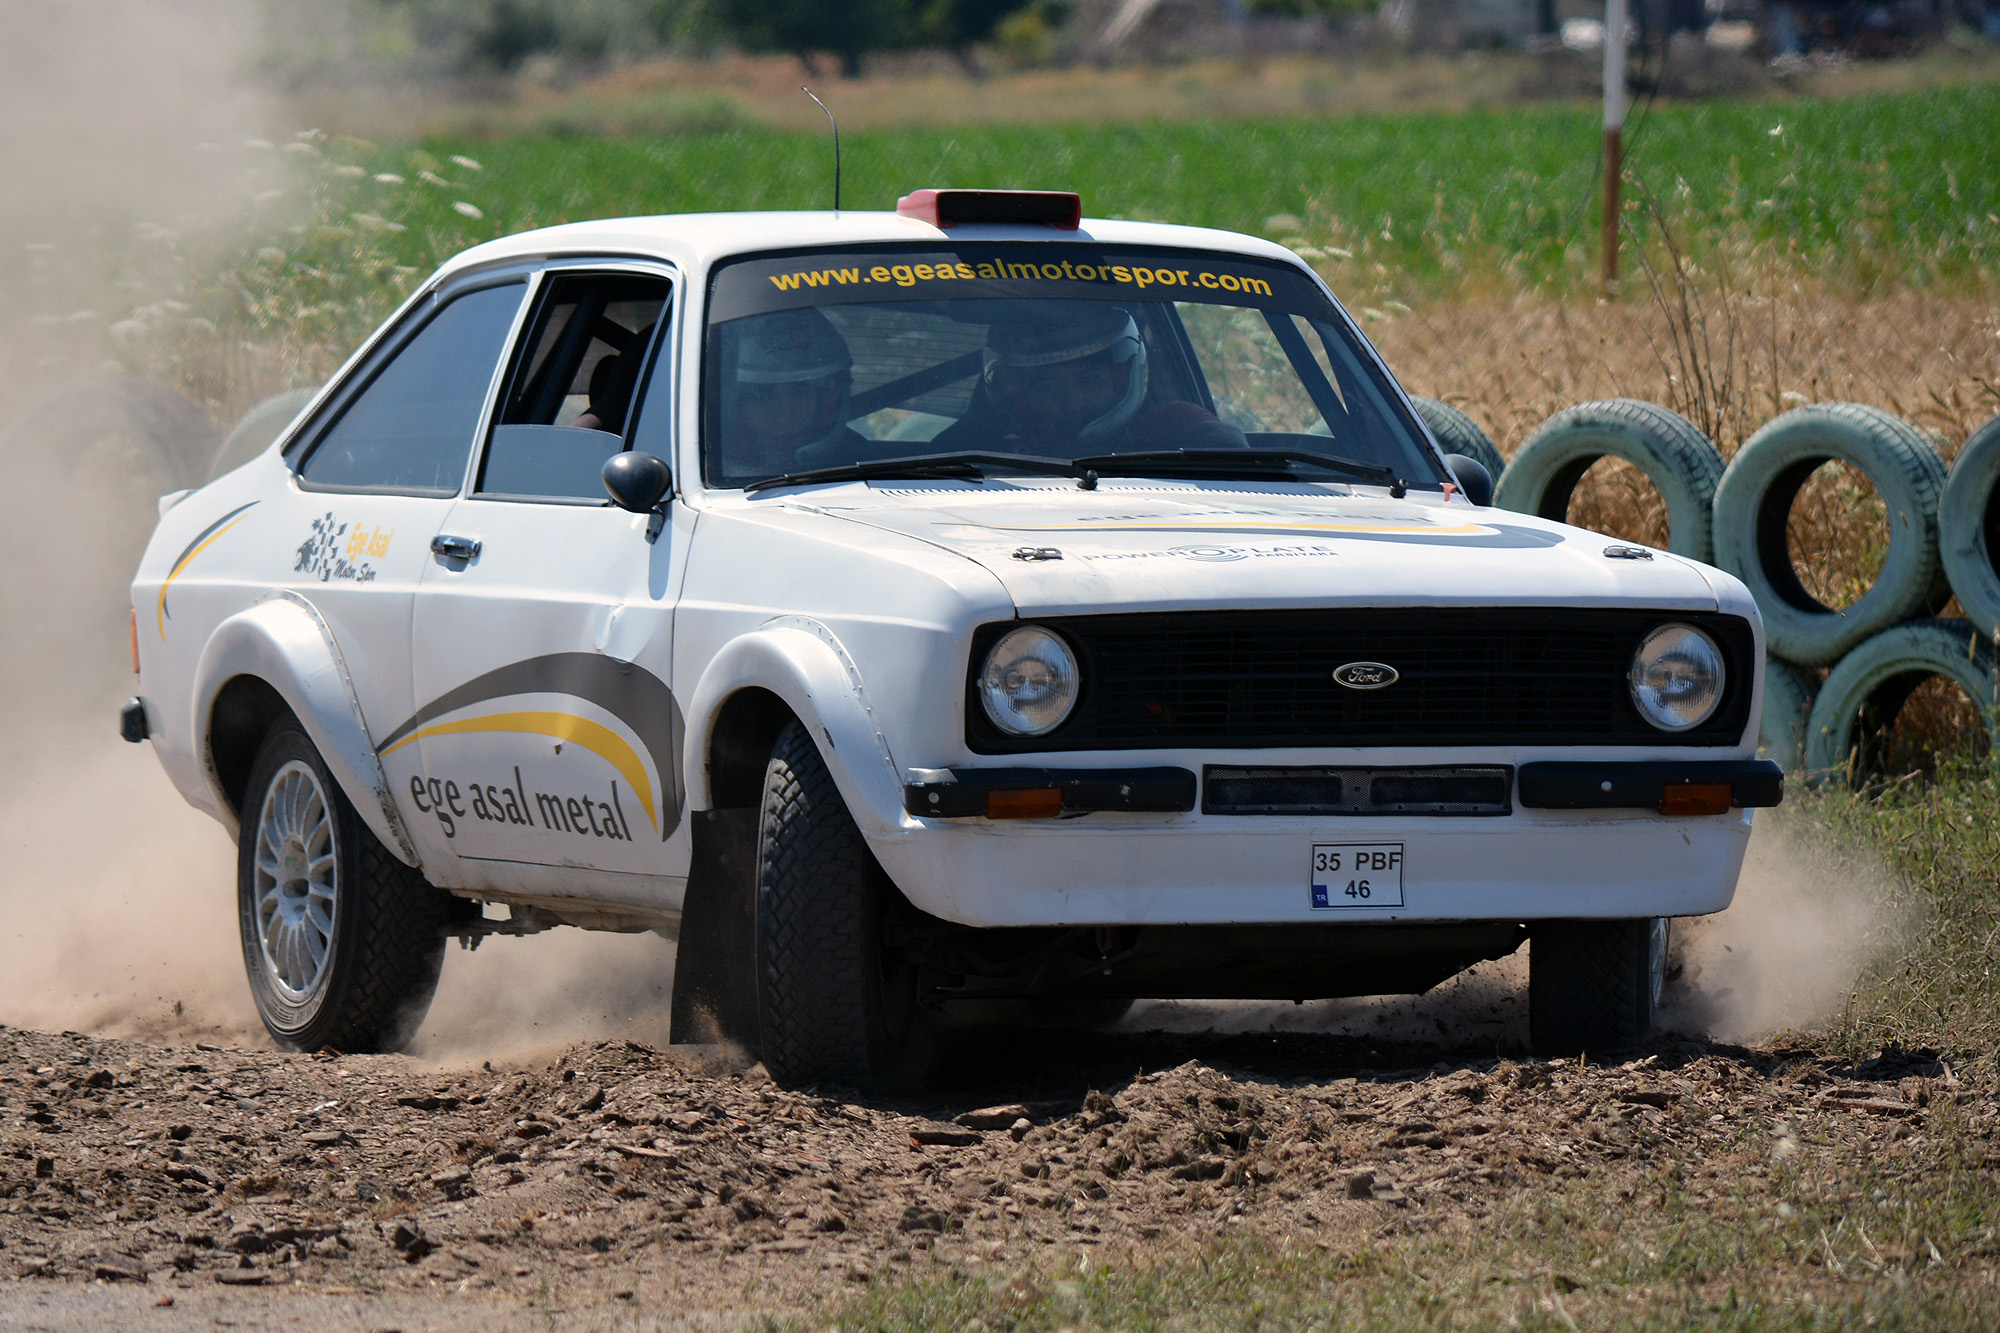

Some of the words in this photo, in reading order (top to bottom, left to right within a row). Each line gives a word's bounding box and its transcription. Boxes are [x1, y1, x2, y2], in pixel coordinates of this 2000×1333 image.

[769, 258, 1273, 297] www.egeasalmotorspor.com
[347, 522, 369, 563] Ege
[366, 526, 396, 559] Asal
[1083, 550, 1188, 561] POWER
[1228, 545, 1332, 554] PLATE
[1348, 666, 1383, 683] Ford
[410, 775, 466, 839] ege
[469, 765, 536, 827] asal
[535, 780, 633, 842] metal
[1315, 852, 1341, 872] 35
[1354, 851, 1403, 871] PBF
[1315, 894, 1327, 902] TR
[1344, 879, 1371, 899] 46
